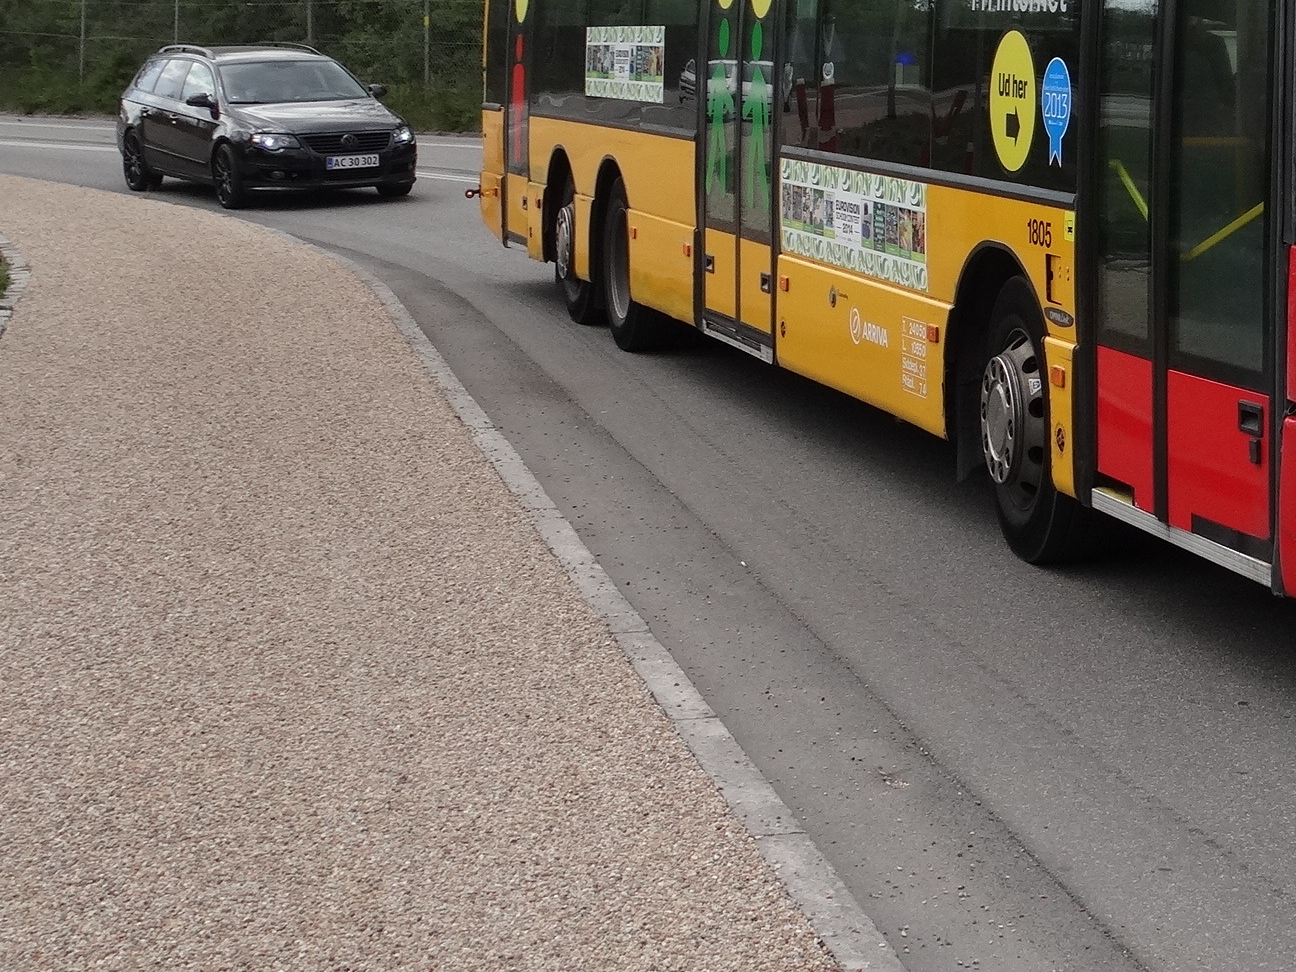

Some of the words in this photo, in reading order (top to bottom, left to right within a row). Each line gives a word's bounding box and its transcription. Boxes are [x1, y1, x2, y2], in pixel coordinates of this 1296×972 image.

[998, 72, 1011, 98] Ud
[1012, 74, 1028, 99] her
[1044, 92, 1068, 119] 2013
[334, 158, 347, 167] AC
[348, 157, 360, 167] 30
[361, 156, 378, 166] 302
[1027, 218, 1052, 248] 1805
[861, 321, 889, 348] ARRIVA
